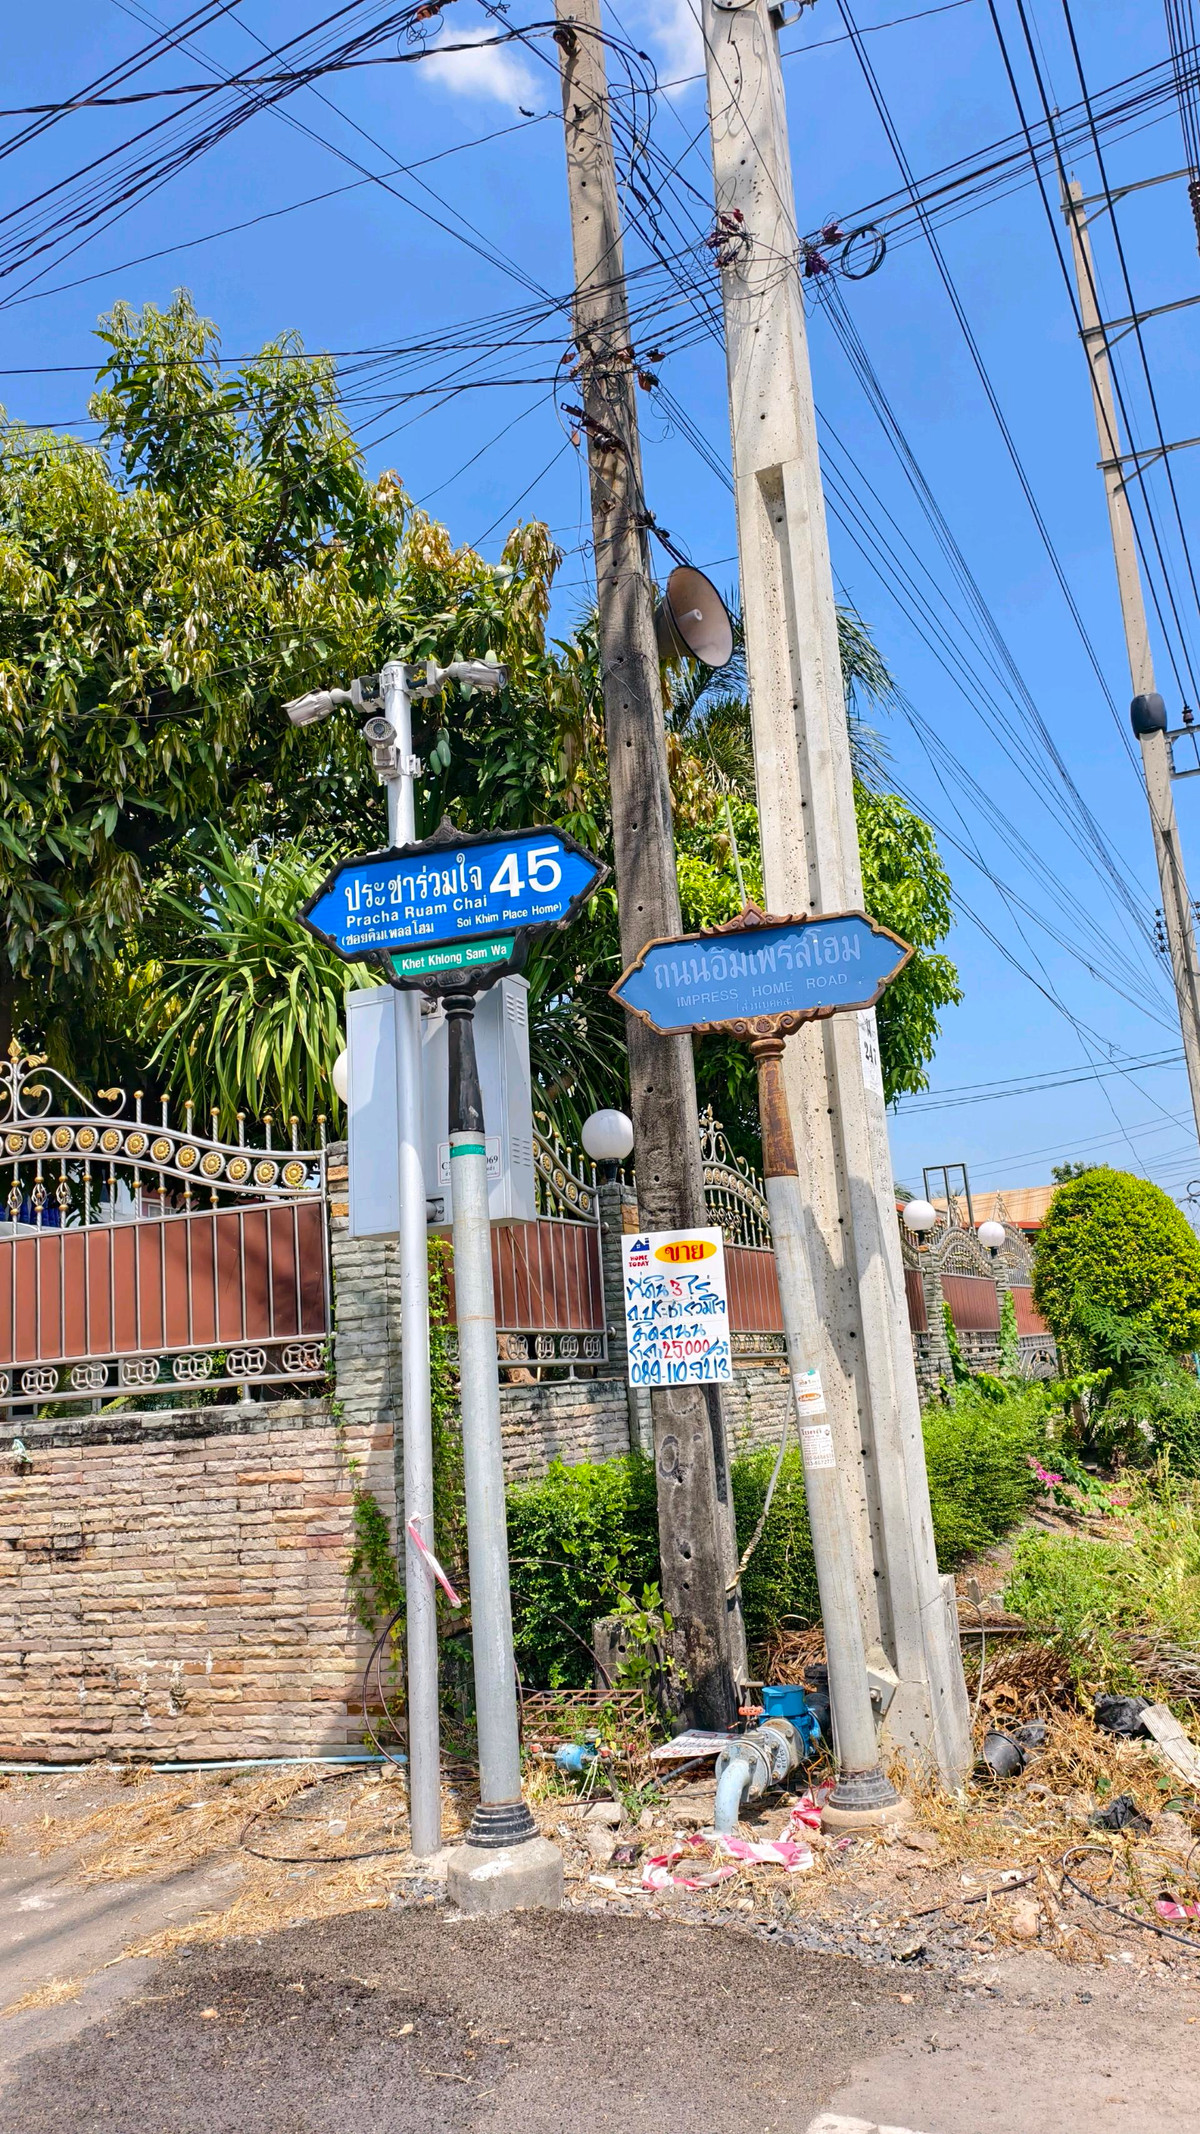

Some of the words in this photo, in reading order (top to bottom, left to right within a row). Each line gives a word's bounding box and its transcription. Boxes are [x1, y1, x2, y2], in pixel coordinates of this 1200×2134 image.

[344, 852, 483, 911] ประชาร่วมใจ
[489, 845, 563, 898] 45
[346, 910, 399, 928] Pracha
[404, 903, 447, 919] Ruam
[453, 894, 487, 911] Chai
[456, 916, 472, 928] Soi
[475, 913, 499, 925] Khim
[502, 909, 528, 920] Place
[531, 902, 562, 916] Home)
[402, 957, 425, 970] Khet
[428, 953, 462, 966] Khlong
[466, 948, 488, 960] Sam
[490, 944, 507, 956] Wa
[654, 928, 861, 989] ถนนอิมเพรสโฮม
[676, 988, 738, 1008] IMPRESS
[751, 980, 794, 997] HOME
[806, 973, 848, 989] ROAD
[664, 1243, 704, 1262] ขาย
[669, 1279, 683, 1297] 3
